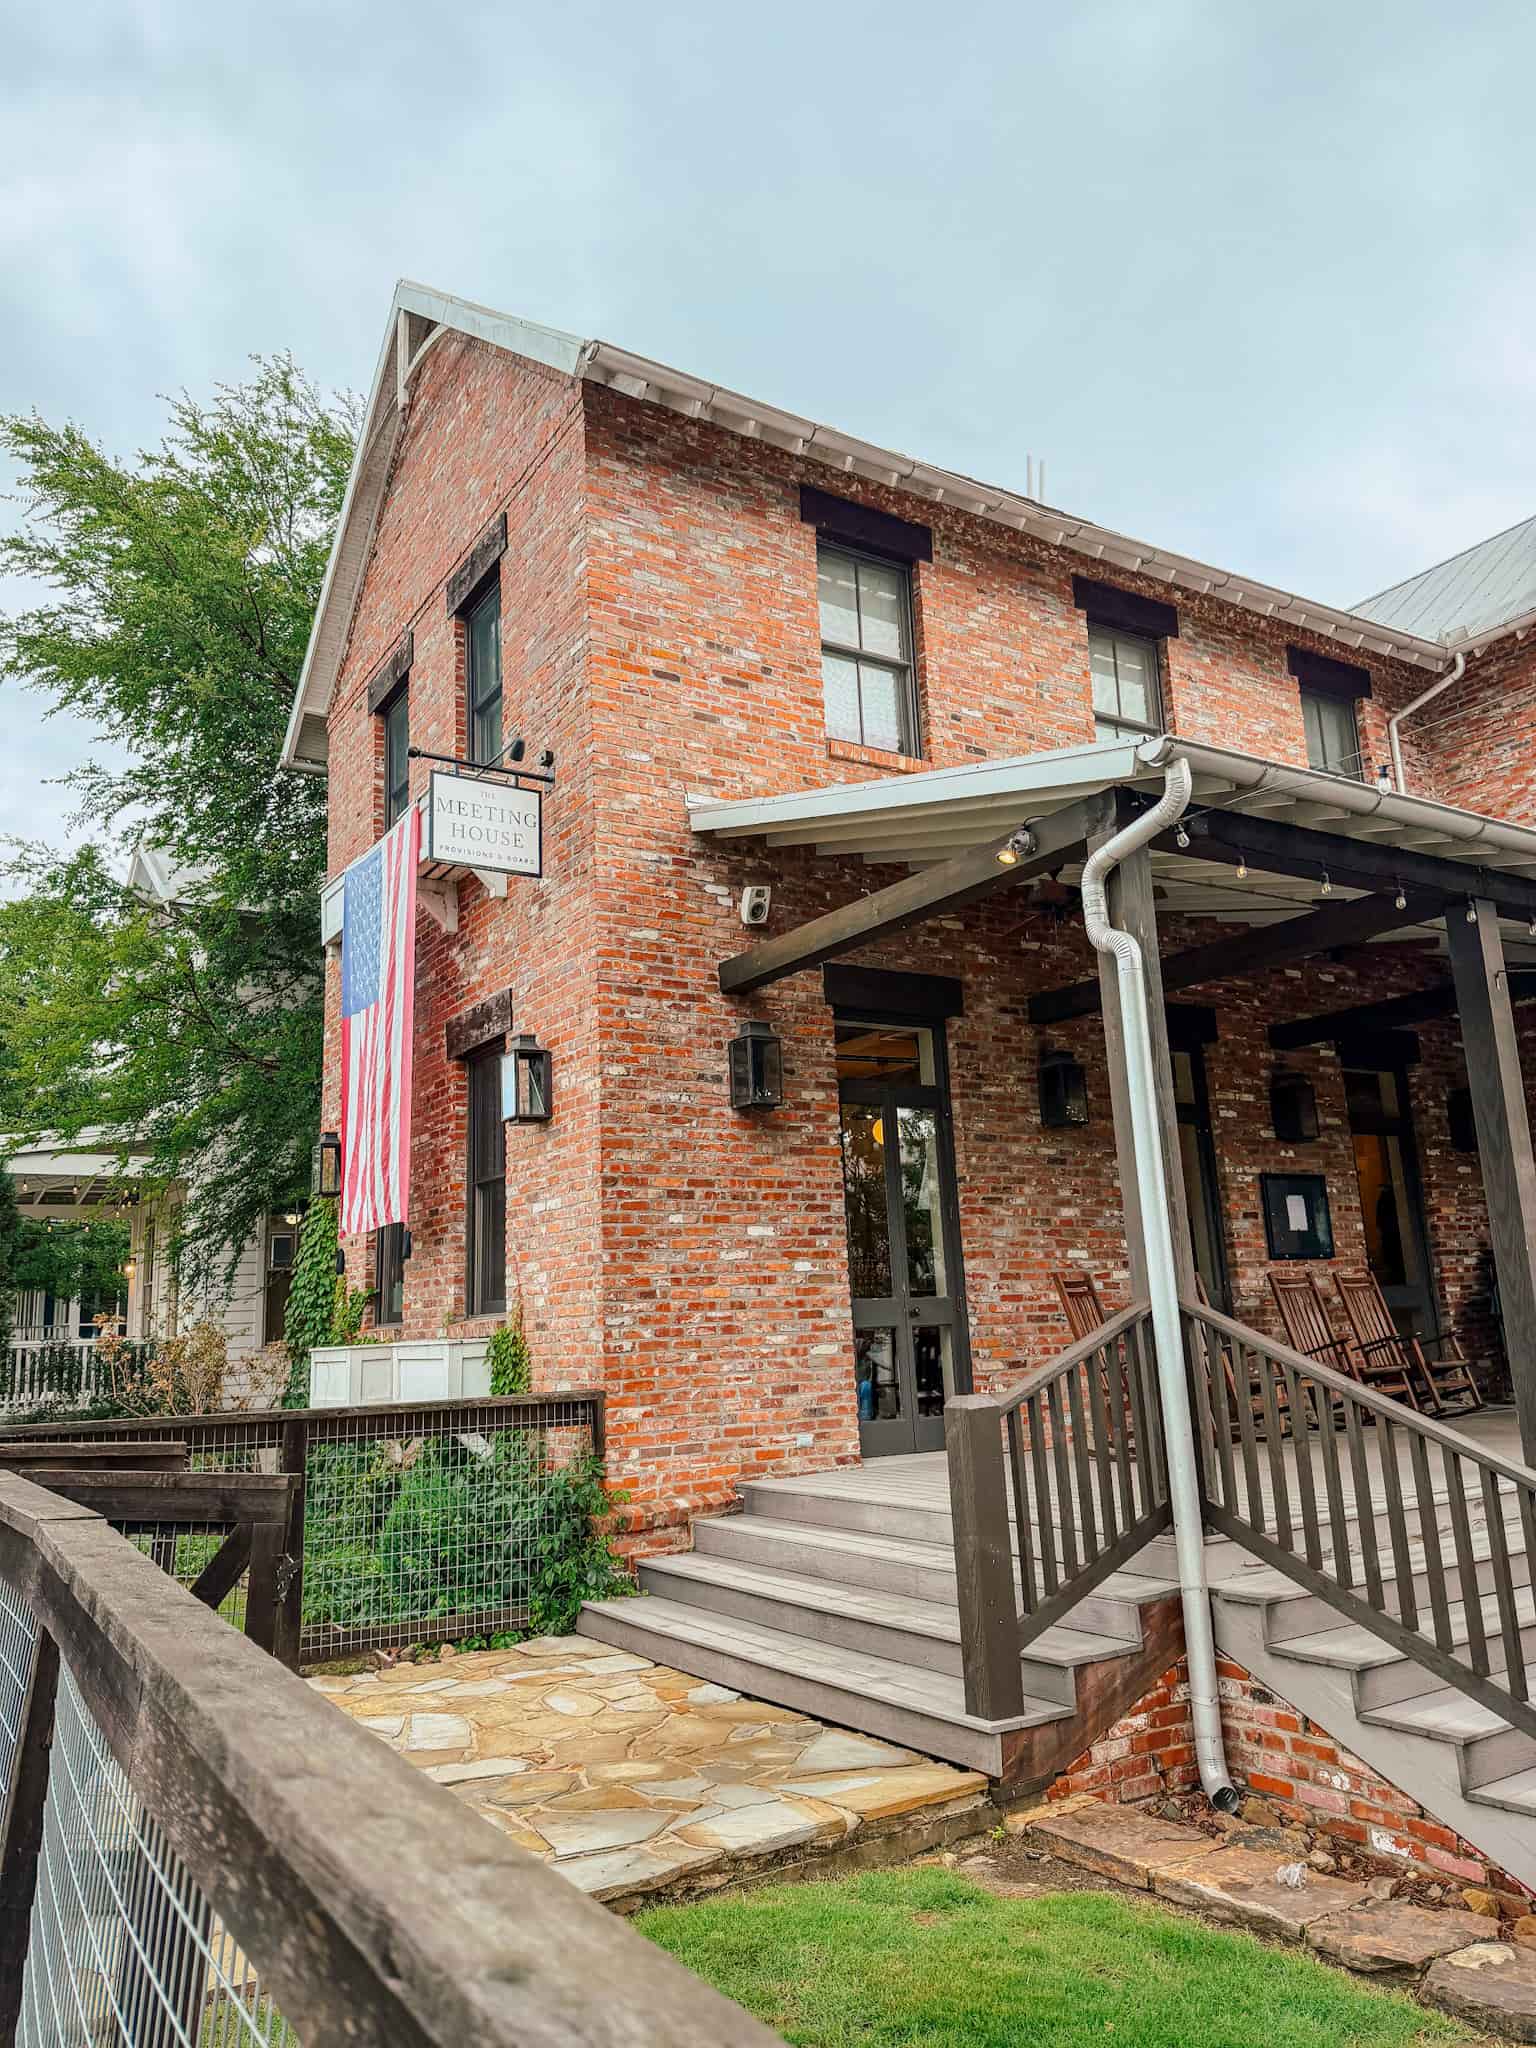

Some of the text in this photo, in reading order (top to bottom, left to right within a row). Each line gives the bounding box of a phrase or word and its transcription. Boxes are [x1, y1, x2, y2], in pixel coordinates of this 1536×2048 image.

[480, 791, 495, 800] THE
[437, 797, 537, 829] MEETING
[451, 822, 524, 848] HOUSE
